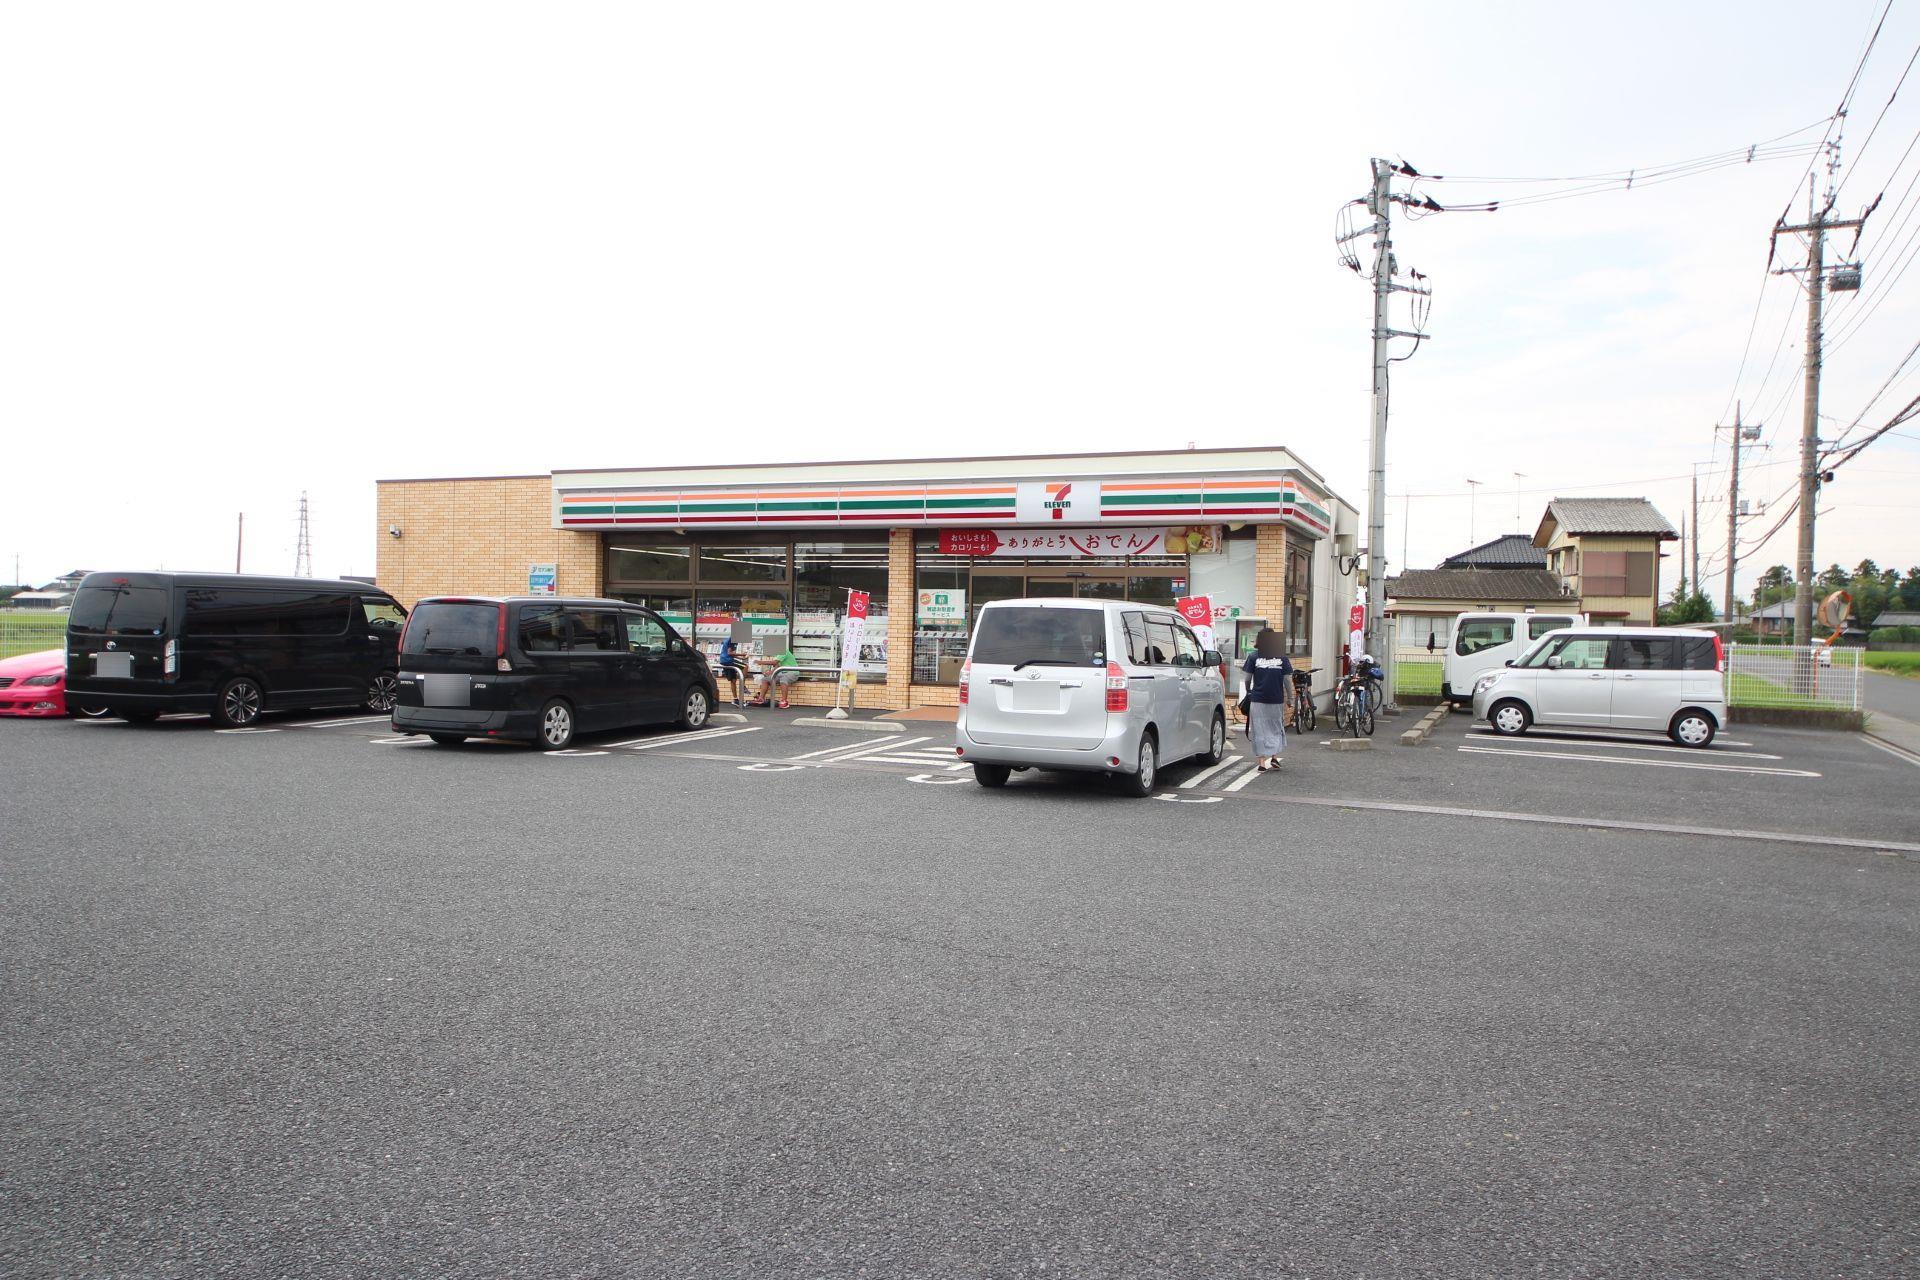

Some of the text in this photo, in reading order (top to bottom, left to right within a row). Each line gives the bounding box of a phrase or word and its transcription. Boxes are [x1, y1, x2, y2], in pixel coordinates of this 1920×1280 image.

[951, 534, 990, 542] おいしさも!
[1008, 533, 1143, 549] ありがとう おでん
[950, 543, 990, 551] カロリーも!
